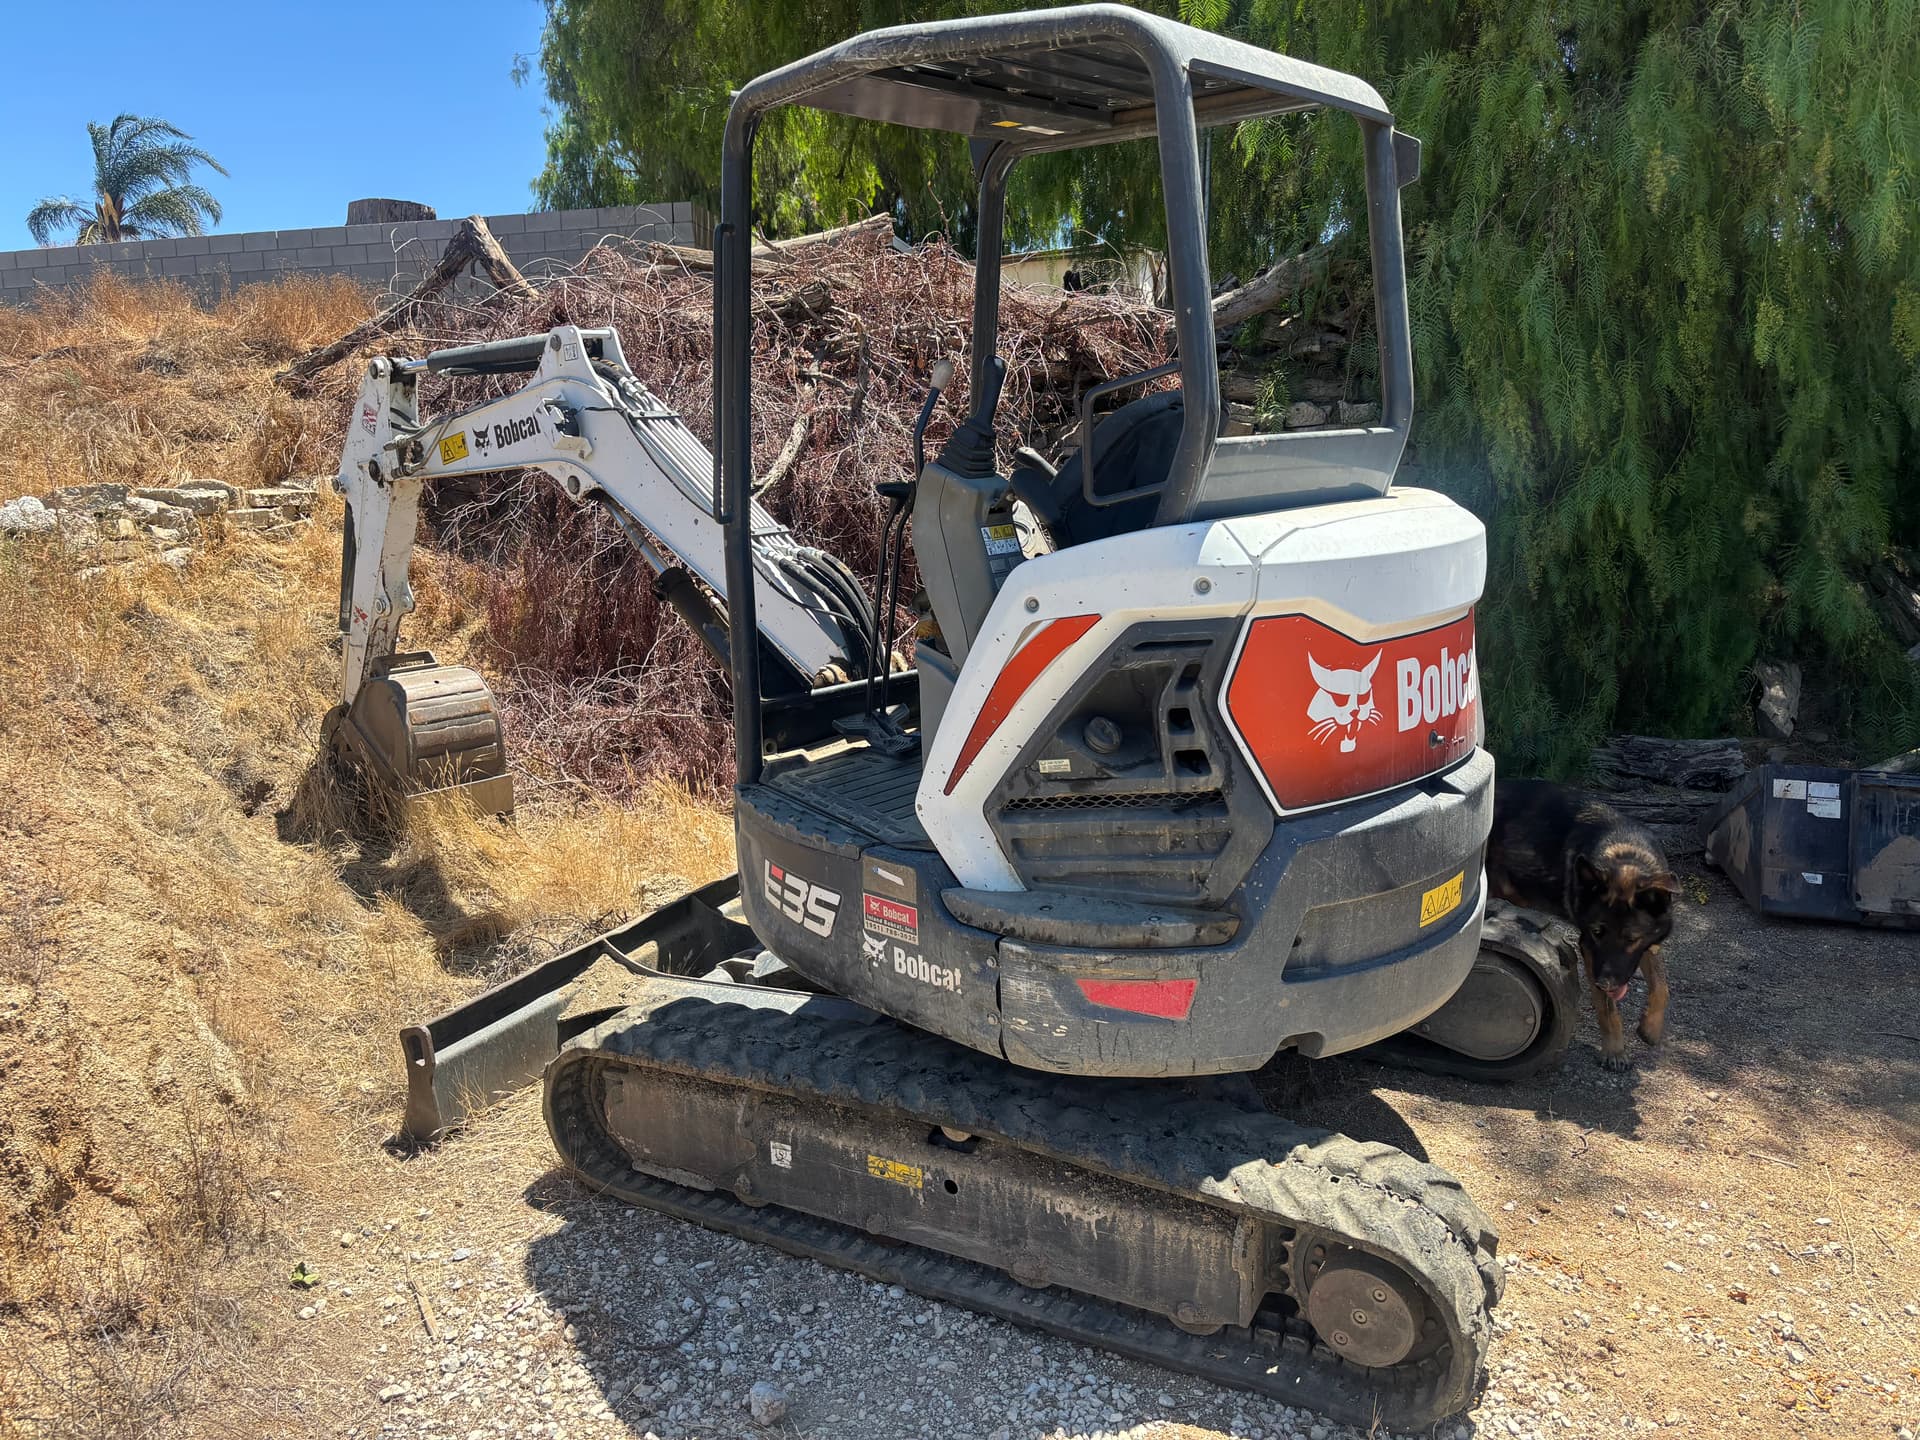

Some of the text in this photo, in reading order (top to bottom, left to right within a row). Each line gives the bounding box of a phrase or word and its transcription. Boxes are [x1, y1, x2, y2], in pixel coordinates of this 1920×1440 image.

[493, 413, 542, 450] Bobcat
[1396, 647, 1477, 733] Bobca
[764, 858, 842, 938] E35
[866, 913, 883, 924] Inland
[882, 905, 910, 924] Bobcat
[893, 946, 963, 995] Bobcat
